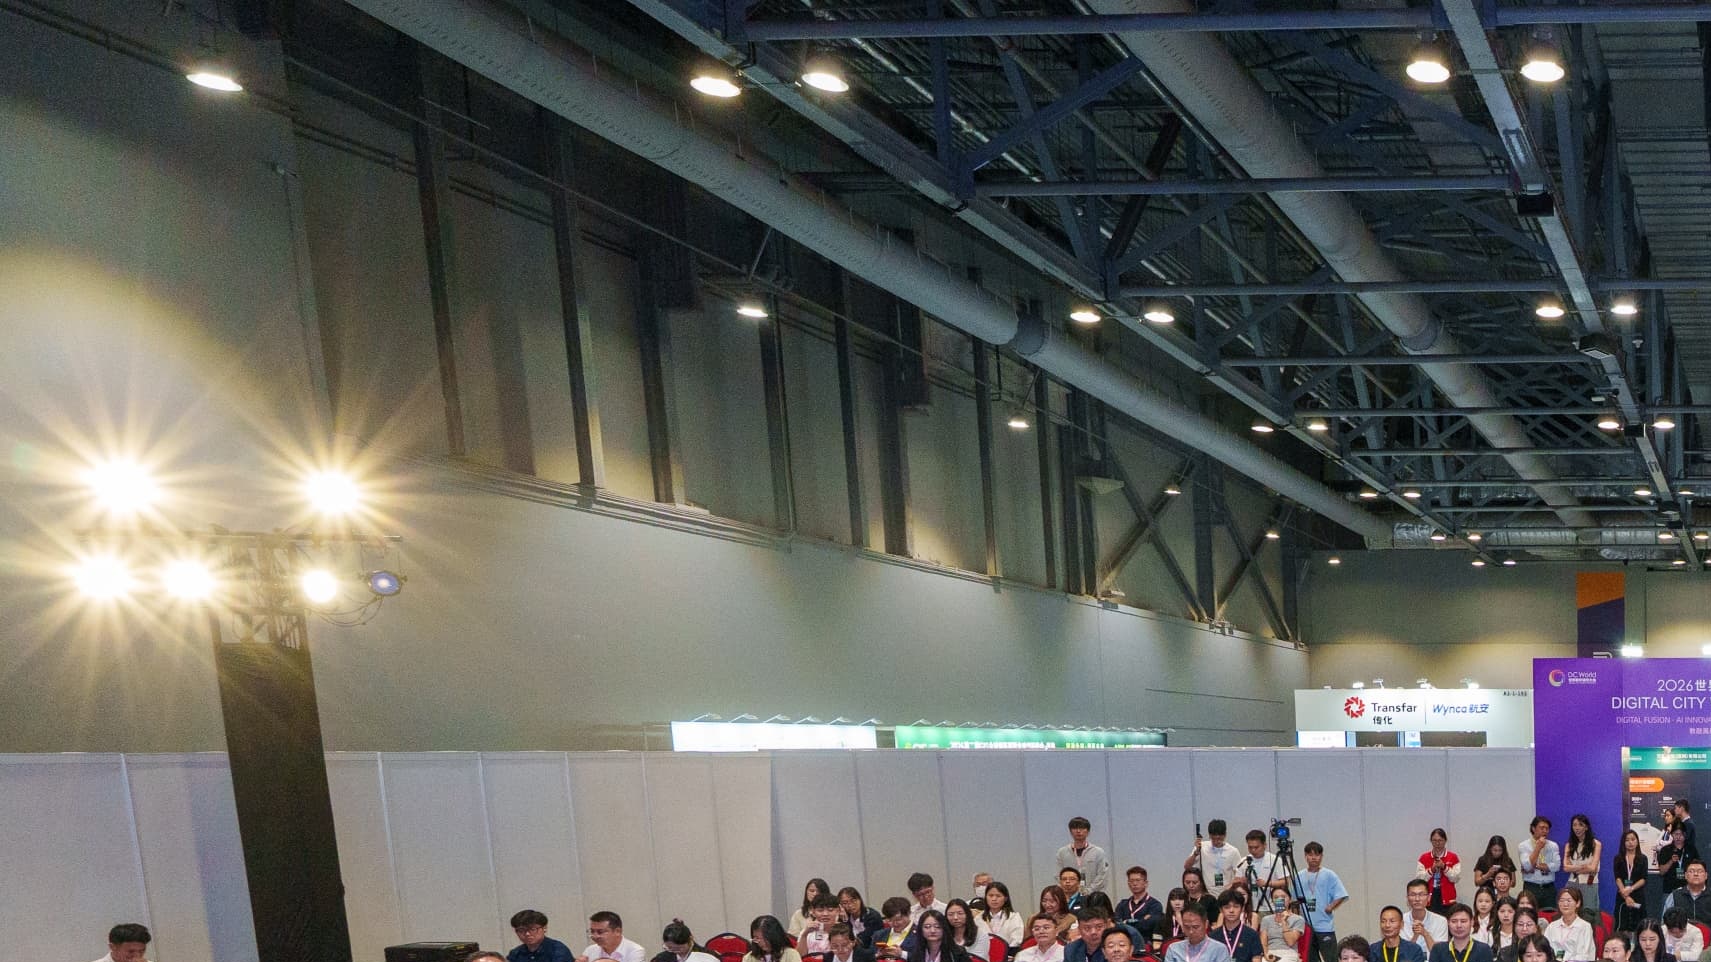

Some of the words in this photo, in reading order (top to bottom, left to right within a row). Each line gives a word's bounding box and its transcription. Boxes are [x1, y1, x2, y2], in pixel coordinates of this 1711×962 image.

[1371, 702, 1417, 713] Transfar
[1611, 697, 1668, 709] DIGITAL
[1672, 697, 1706, 709] CITY
[1433, 704, 1467, 716] Wynca
[1616, 716, 1641, 724] DIGITAL
[1644, 716, 1671, 724] FUSION
